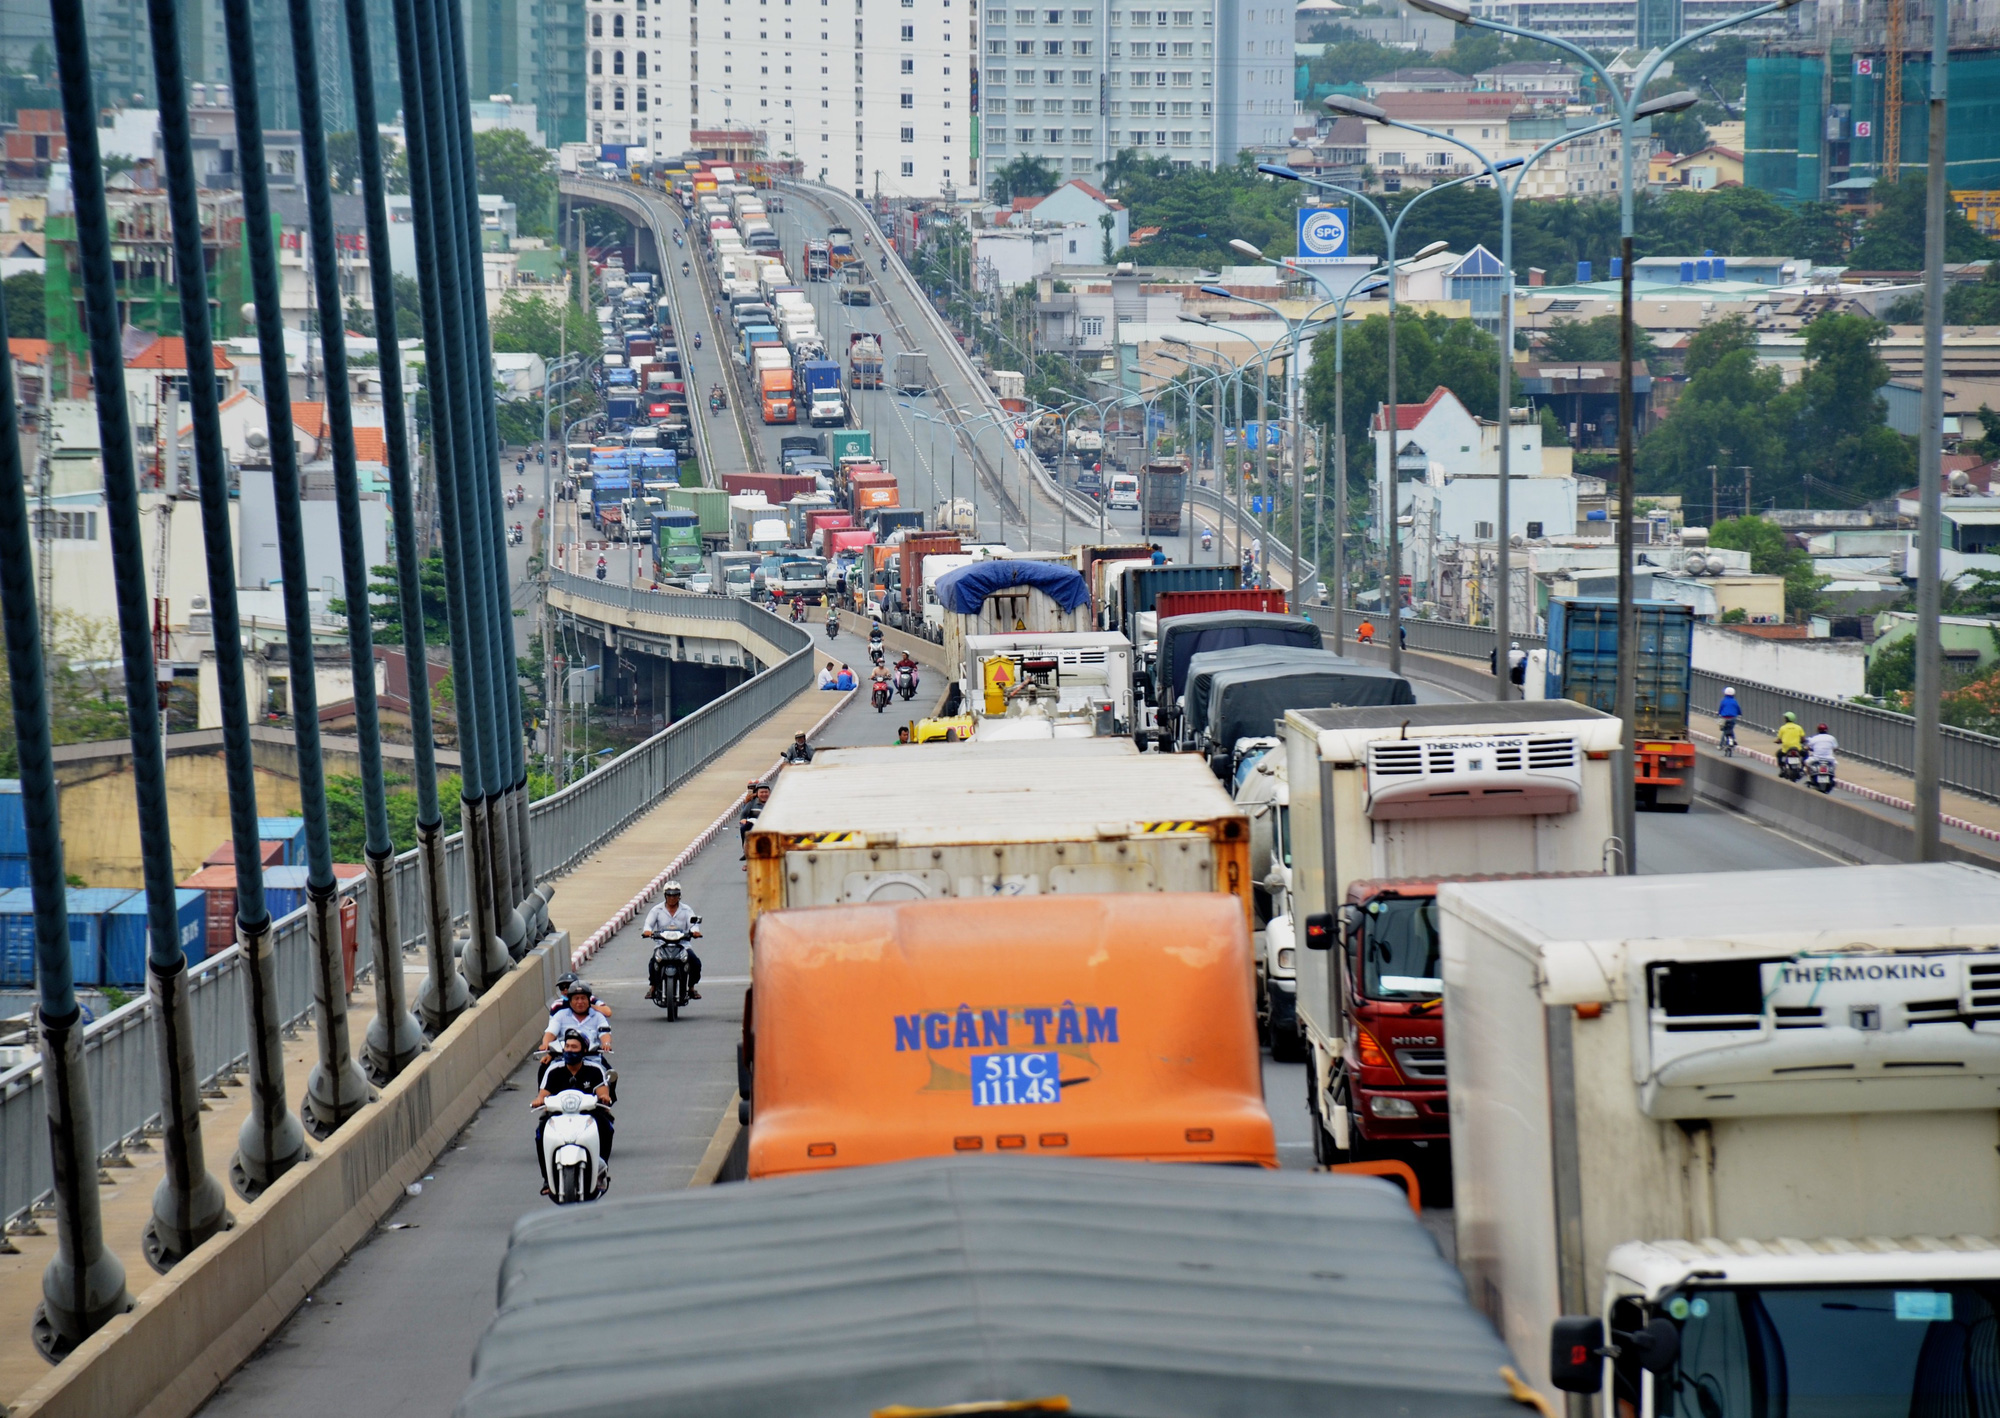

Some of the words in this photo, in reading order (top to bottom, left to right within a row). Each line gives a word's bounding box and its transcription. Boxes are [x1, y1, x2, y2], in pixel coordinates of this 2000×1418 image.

[1859, 60, 1871, 74] 8
[1857, 122, 1870, 137] 6
[1316, 227, 1340, 238] SPC
[953, 507, 973, 517] LPG
[1426, 741, 1483, 750] THERMO
[1487, 739, 1522, 748] KING
[1782, 963, 1945, 984] THERMOKING
[893, 1002, 1009, 1052] NGÂN
[1023, 999, 1120, 1046] TÂM
[1391, 1036, 1438, 1045] HINO
[985, 1053, 1048, 1081] 51C
[977, 1077, 1057, 1106] 111.45
